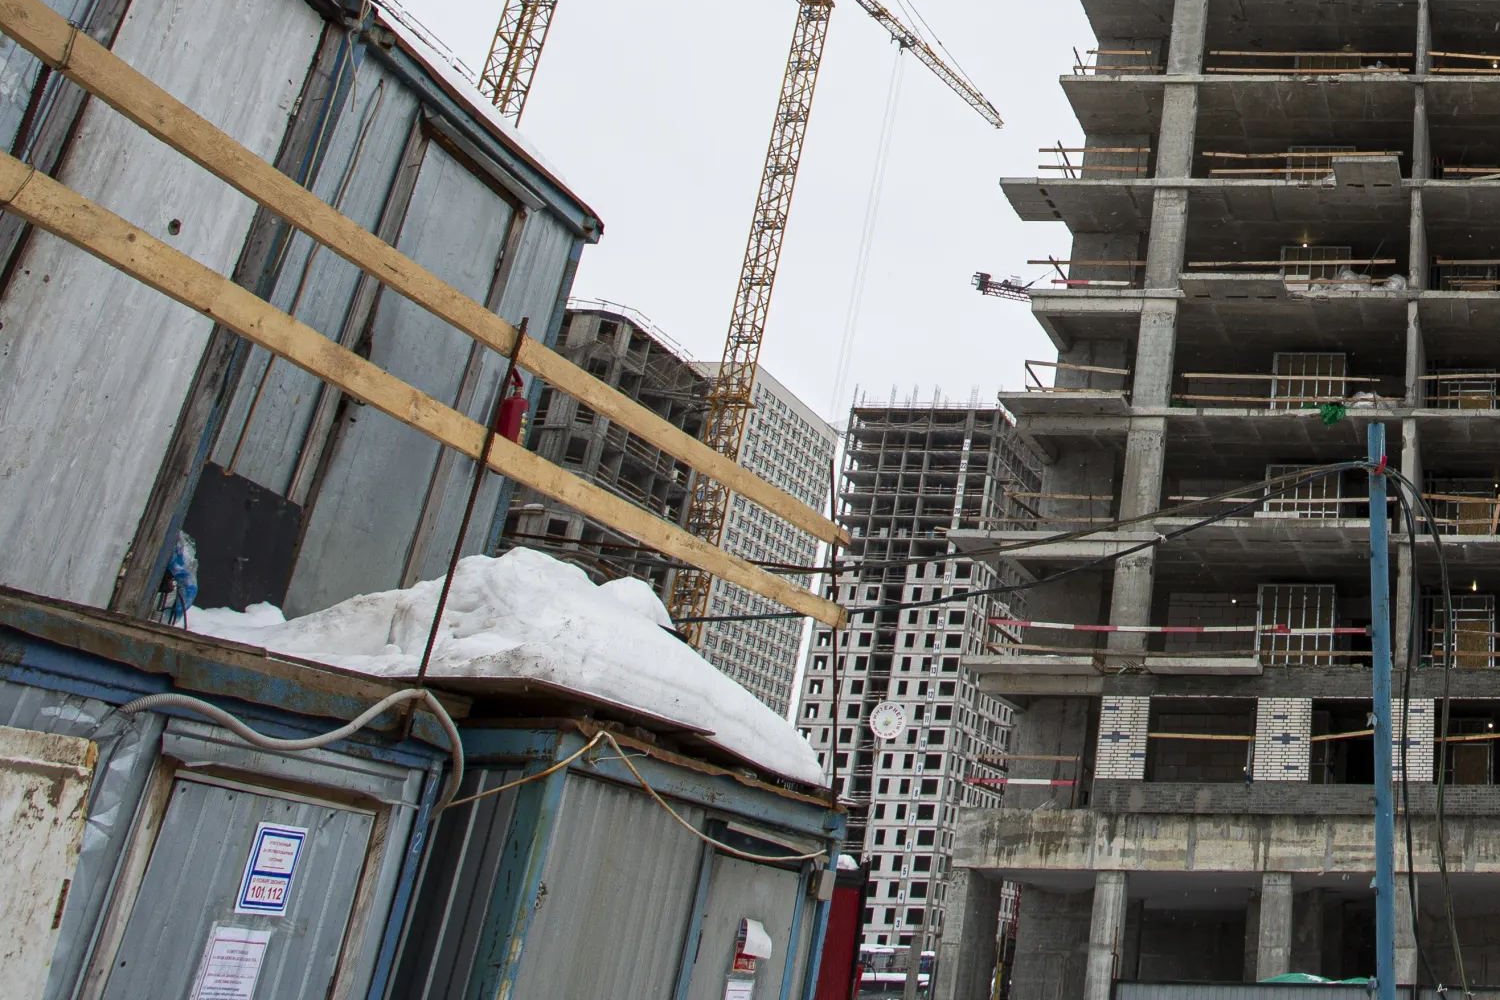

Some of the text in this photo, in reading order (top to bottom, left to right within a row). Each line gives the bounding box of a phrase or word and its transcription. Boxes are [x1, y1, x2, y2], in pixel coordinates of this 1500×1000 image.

[873, 704, 903, 720] ИНТЕРНЕТ
[251, 885, 283, 901] 101, 112
